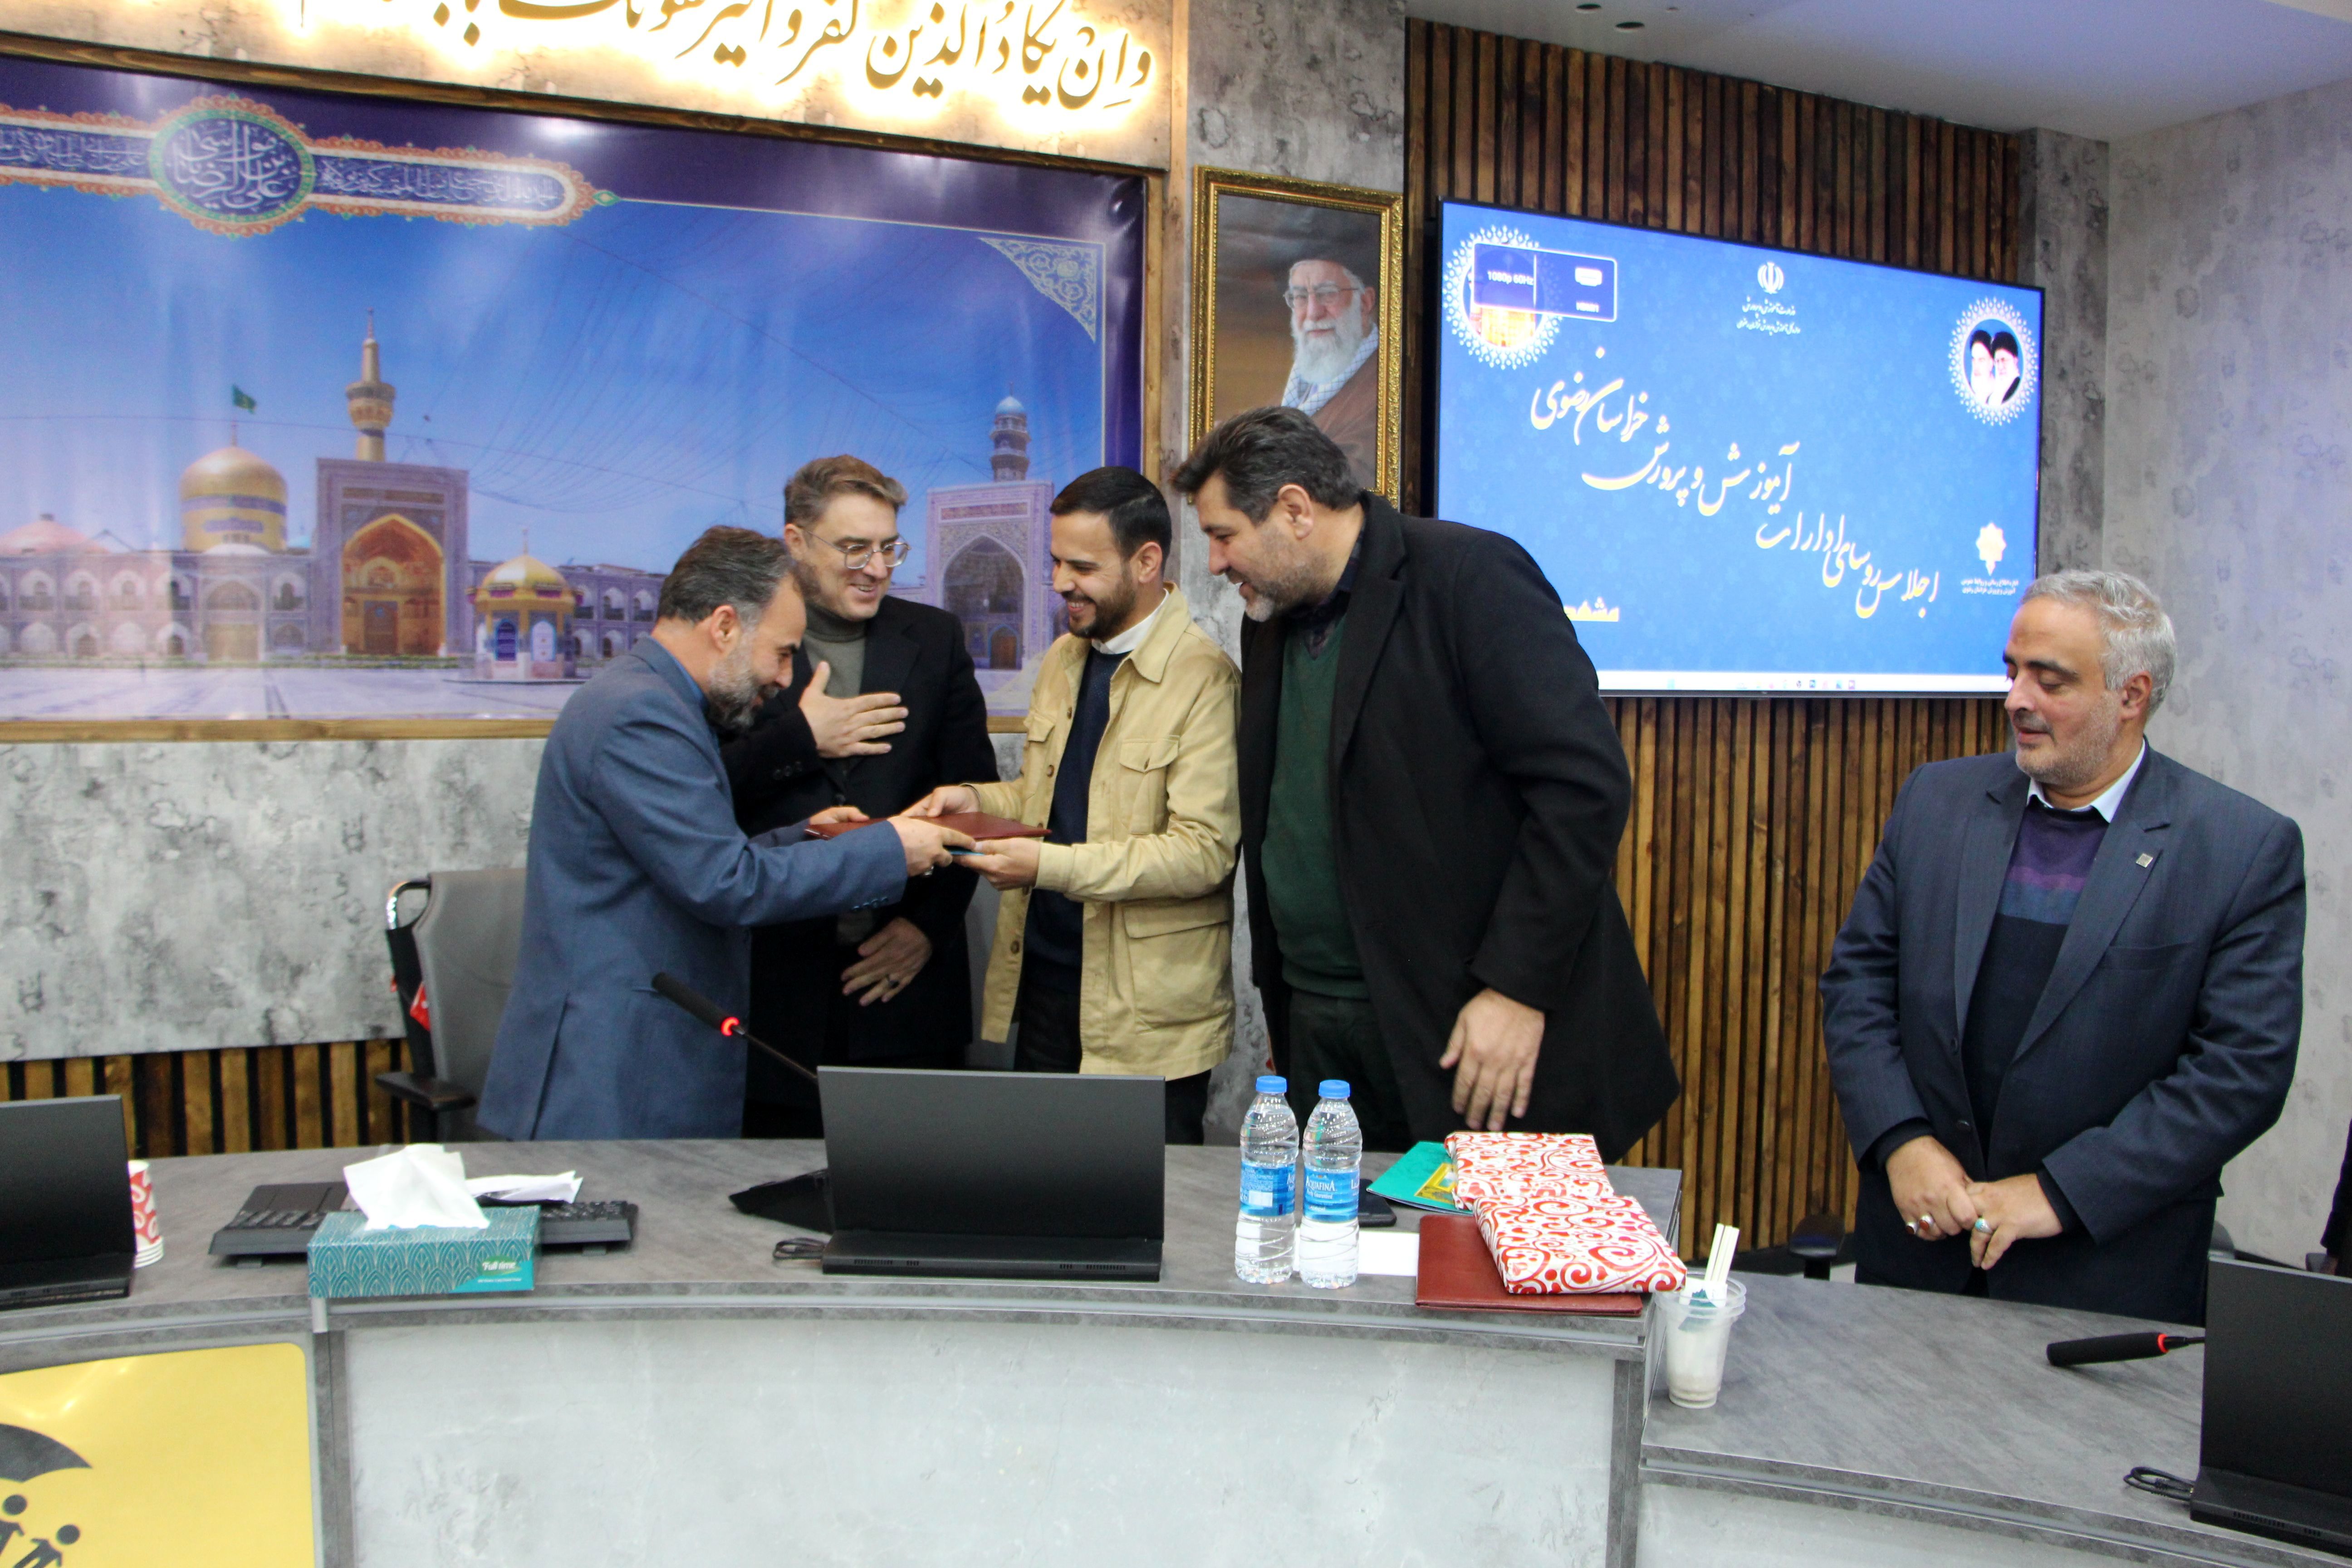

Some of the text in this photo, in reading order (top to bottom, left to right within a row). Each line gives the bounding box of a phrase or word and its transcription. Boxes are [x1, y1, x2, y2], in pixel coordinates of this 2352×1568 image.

[1487, 271, 1534, 286] 1080p 60Hz
[1530, 346, 1649, 446] خراسان رضوی
[1581, 415, 1800, 517] آموزش و پرورش
[1755, 503, 1845, 553] ادارات
[1855, 568, 1940, 619] اجلاس
[1306, 1176, 1335, 1191] AQUAFINA
